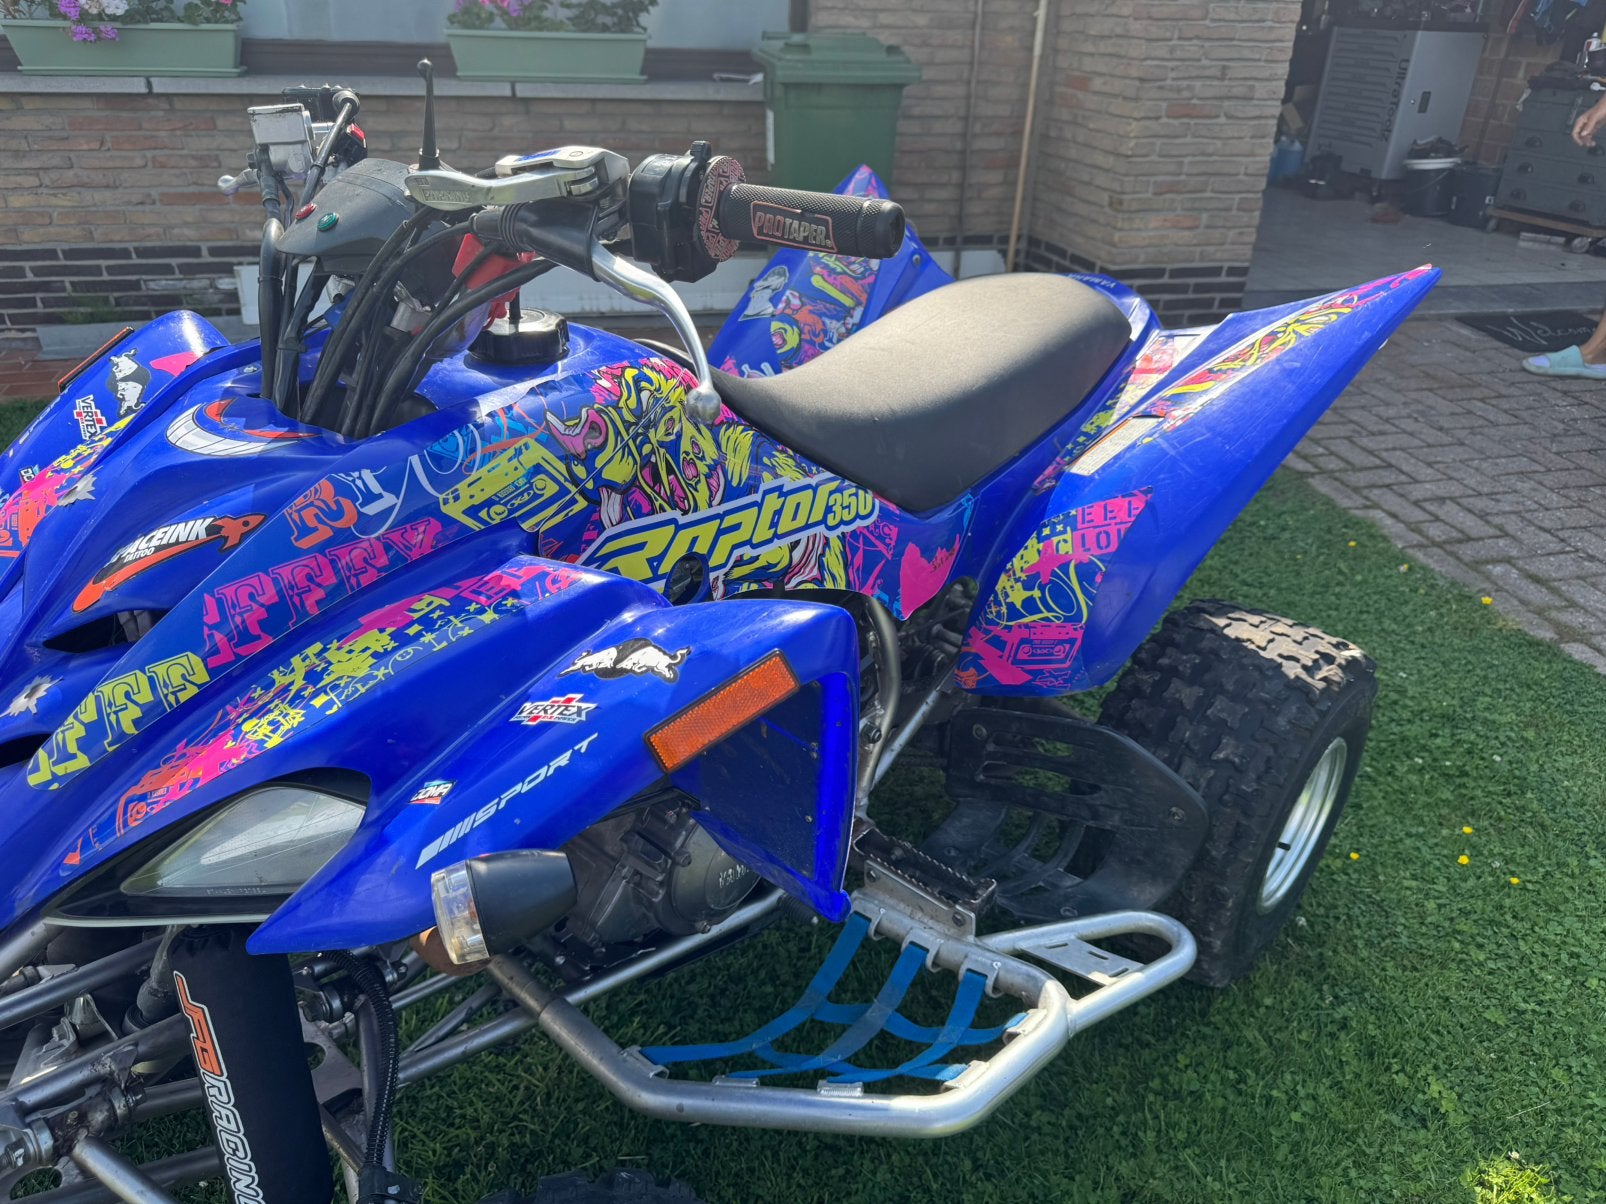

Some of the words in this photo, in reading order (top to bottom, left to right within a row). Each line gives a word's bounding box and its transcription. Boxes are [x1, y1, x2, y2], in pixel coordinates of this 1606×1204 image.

[81, 396, 99, 439] VERTEX
[826, 488, 873, 528] 350
[124, 546, 155, 563] TATTOO
[518, 703, 592, 718] VERTEX
[203, 1072, 263, 1204] RACIN
